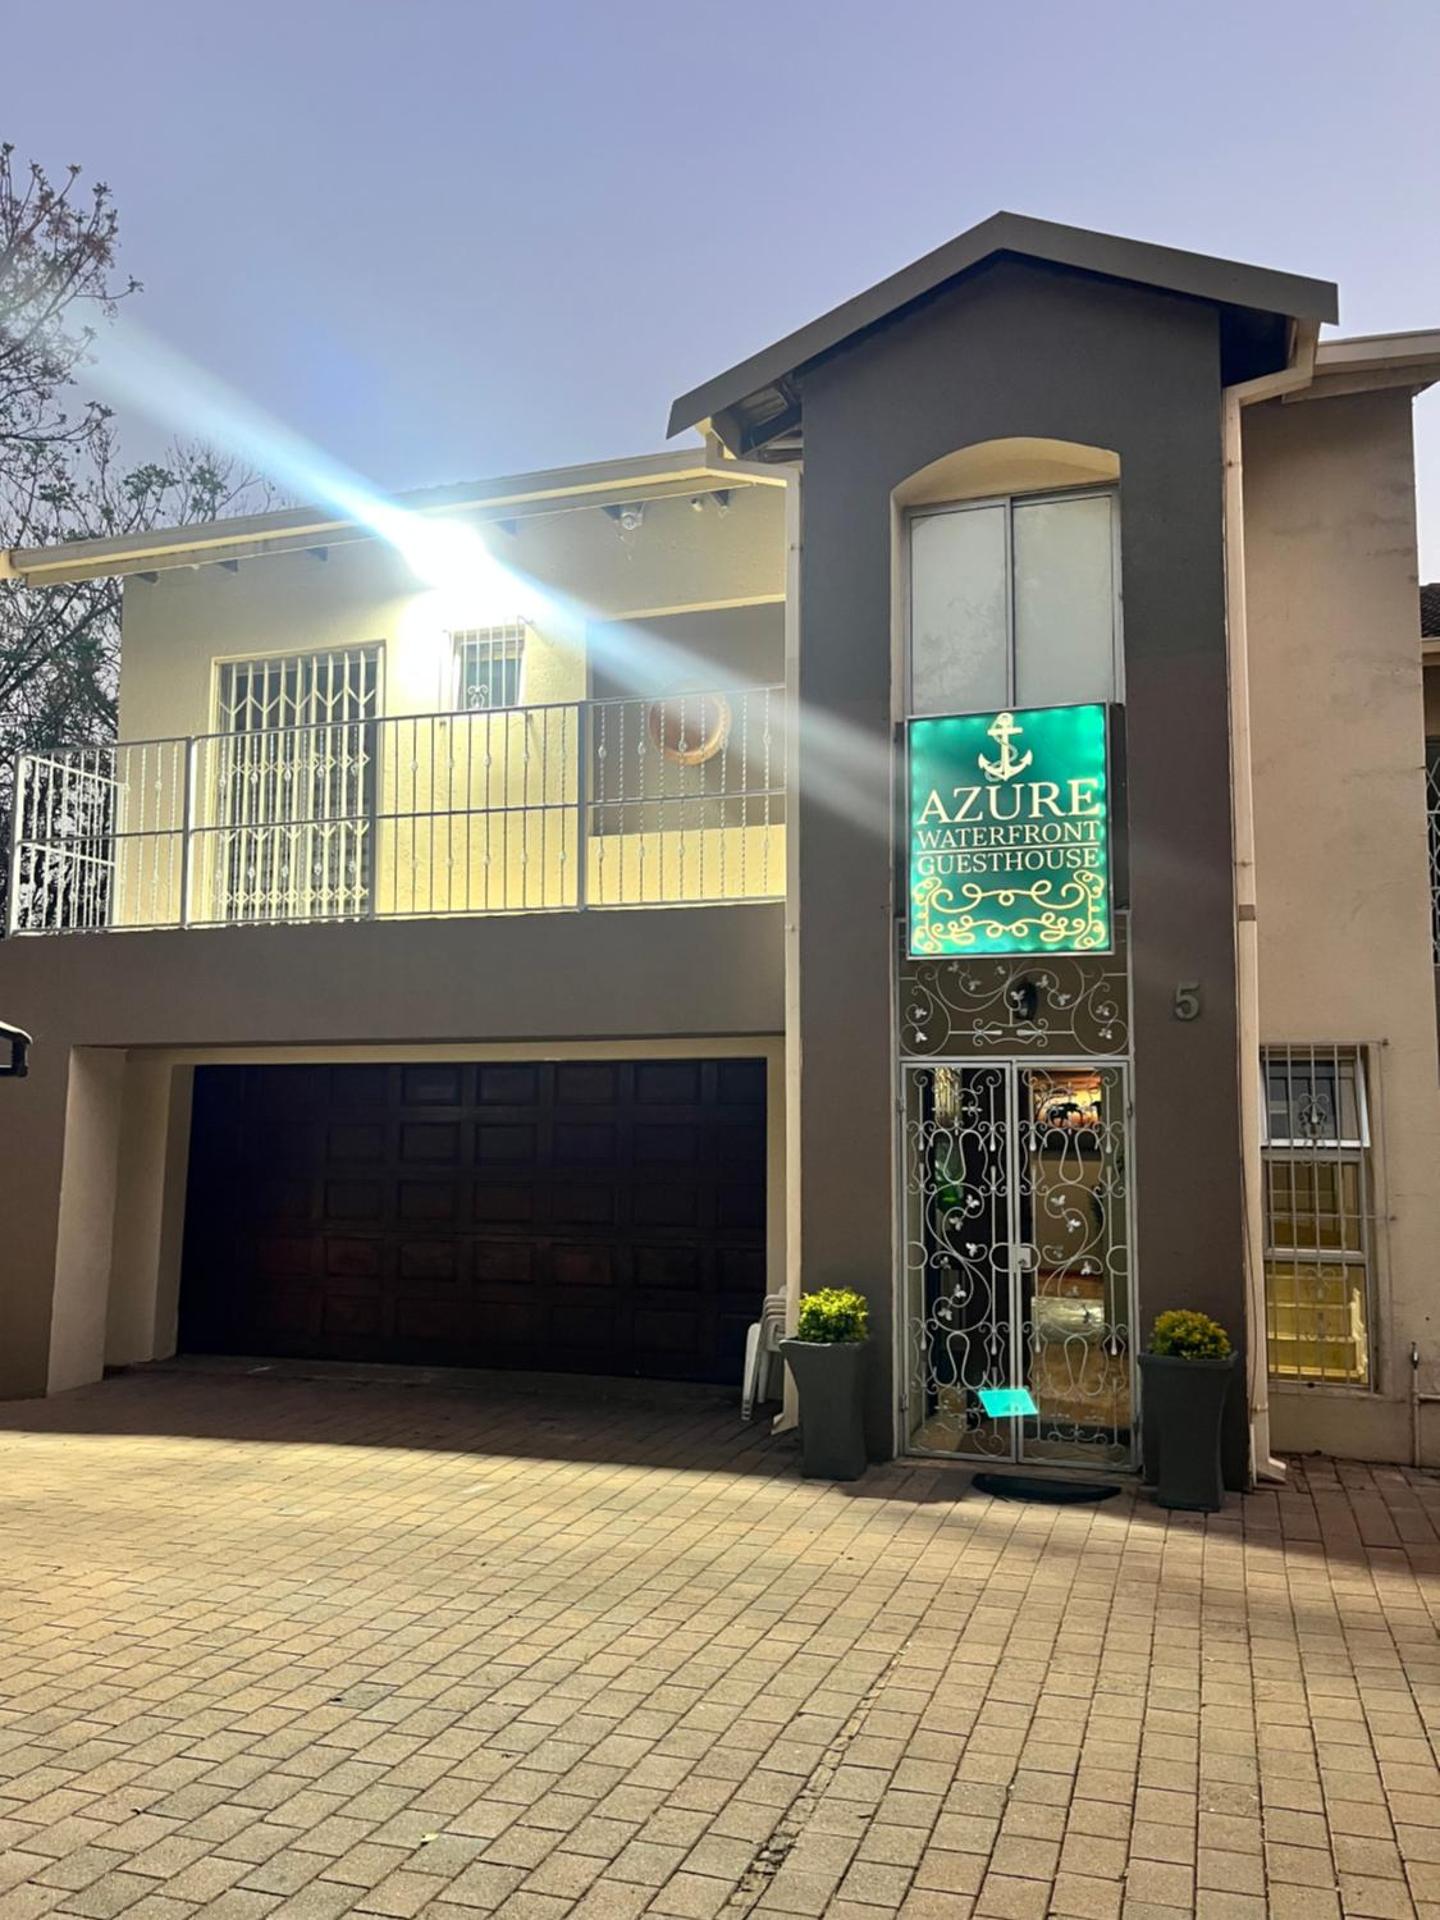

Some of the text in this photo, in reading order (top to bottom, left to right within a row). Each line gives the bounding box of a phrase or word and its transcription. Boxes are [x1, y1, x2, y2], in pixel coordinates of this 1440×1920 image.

[916, 777, 1101, 825] AZURE
[917, 820, 1100, 849] WATERFRONT
[917, 848, 1100, 875] GUESTHOUSE
[1173, 982, 1200, 1021] 5
